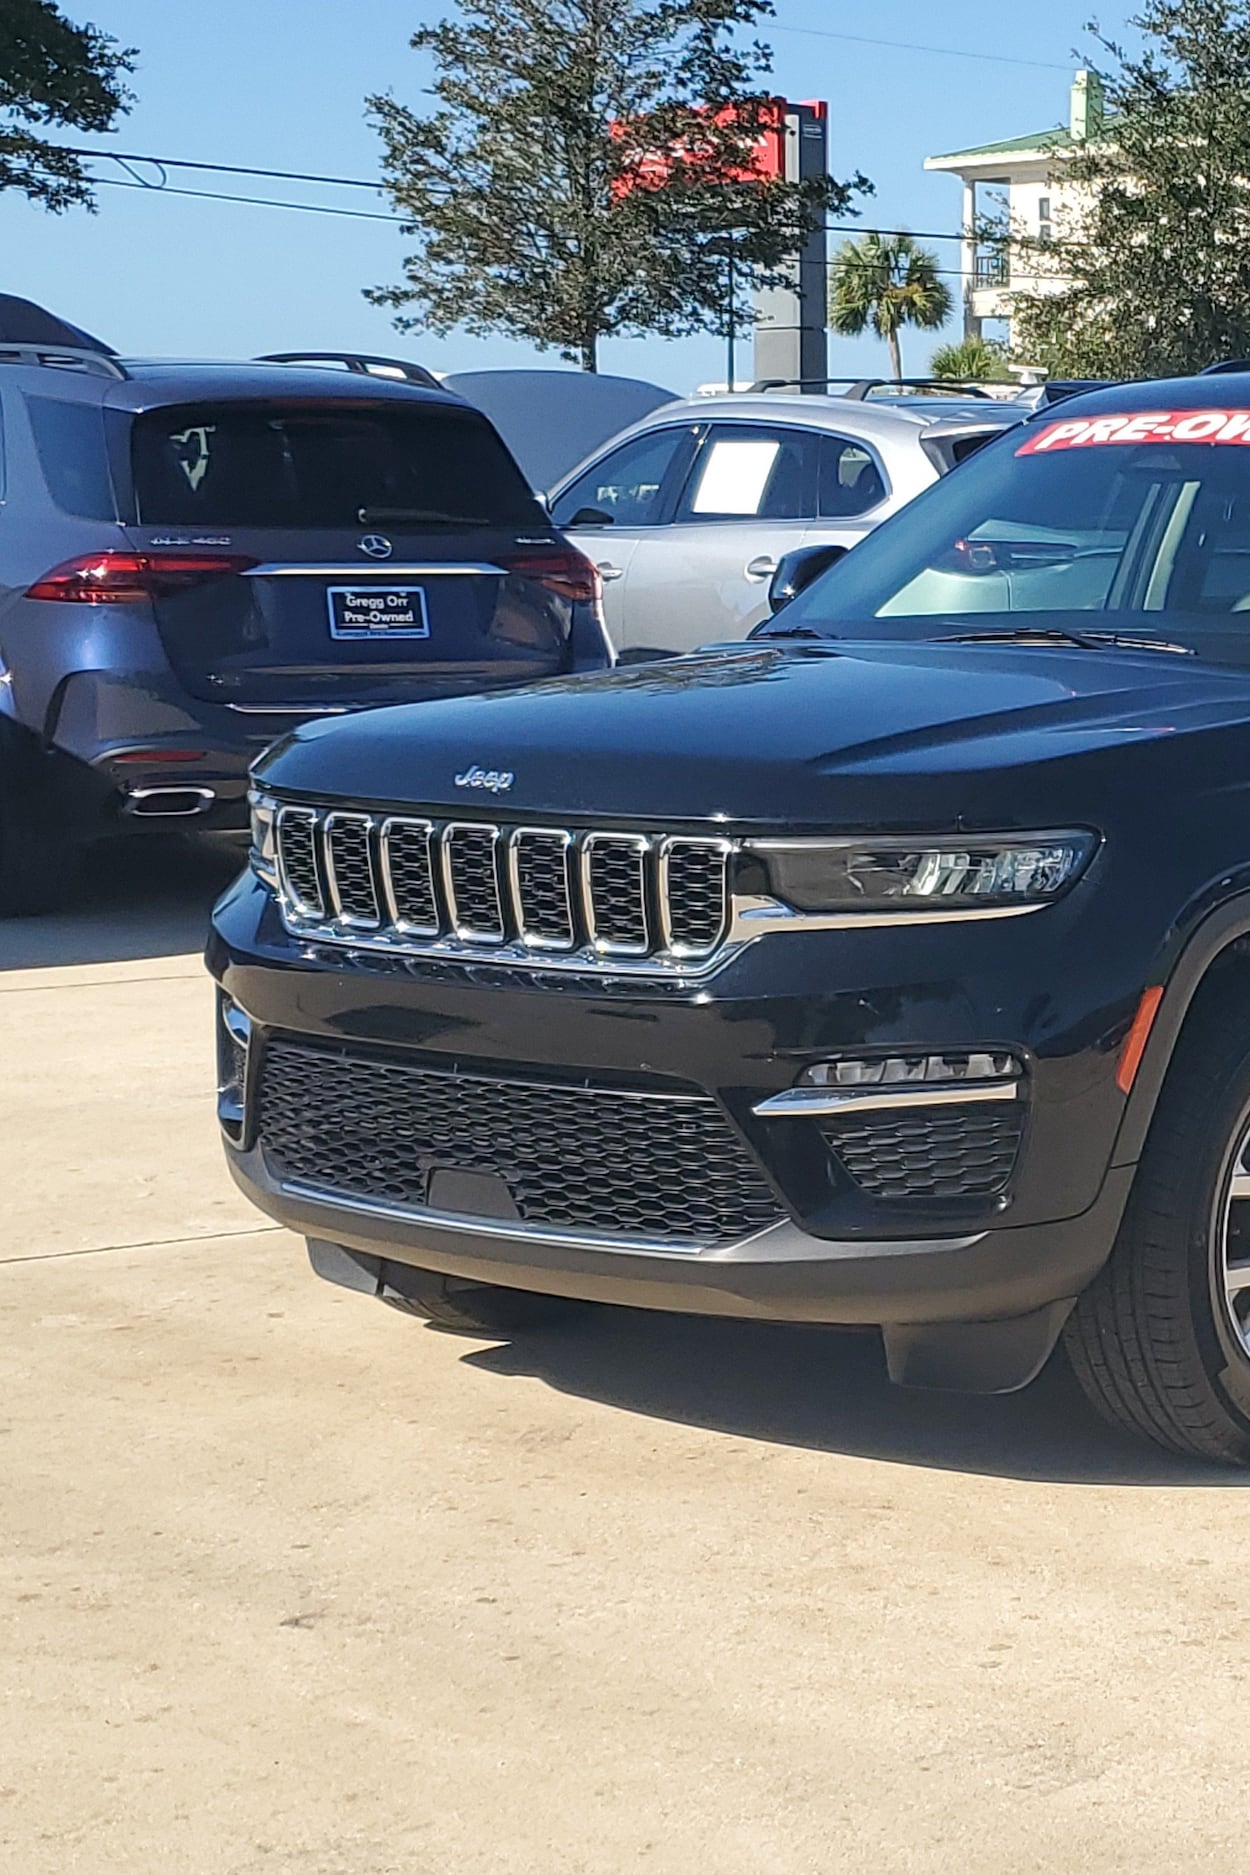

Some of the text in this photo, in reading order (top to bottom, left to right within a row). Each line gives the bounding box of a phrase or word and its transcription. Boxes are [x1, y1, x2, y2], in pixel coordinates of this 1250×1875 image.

[345, 594, 408, 609] Gregg Orr
[344, 609, 414, 622] Pre-Owned
[455, 765, 514, 793] Jeep
